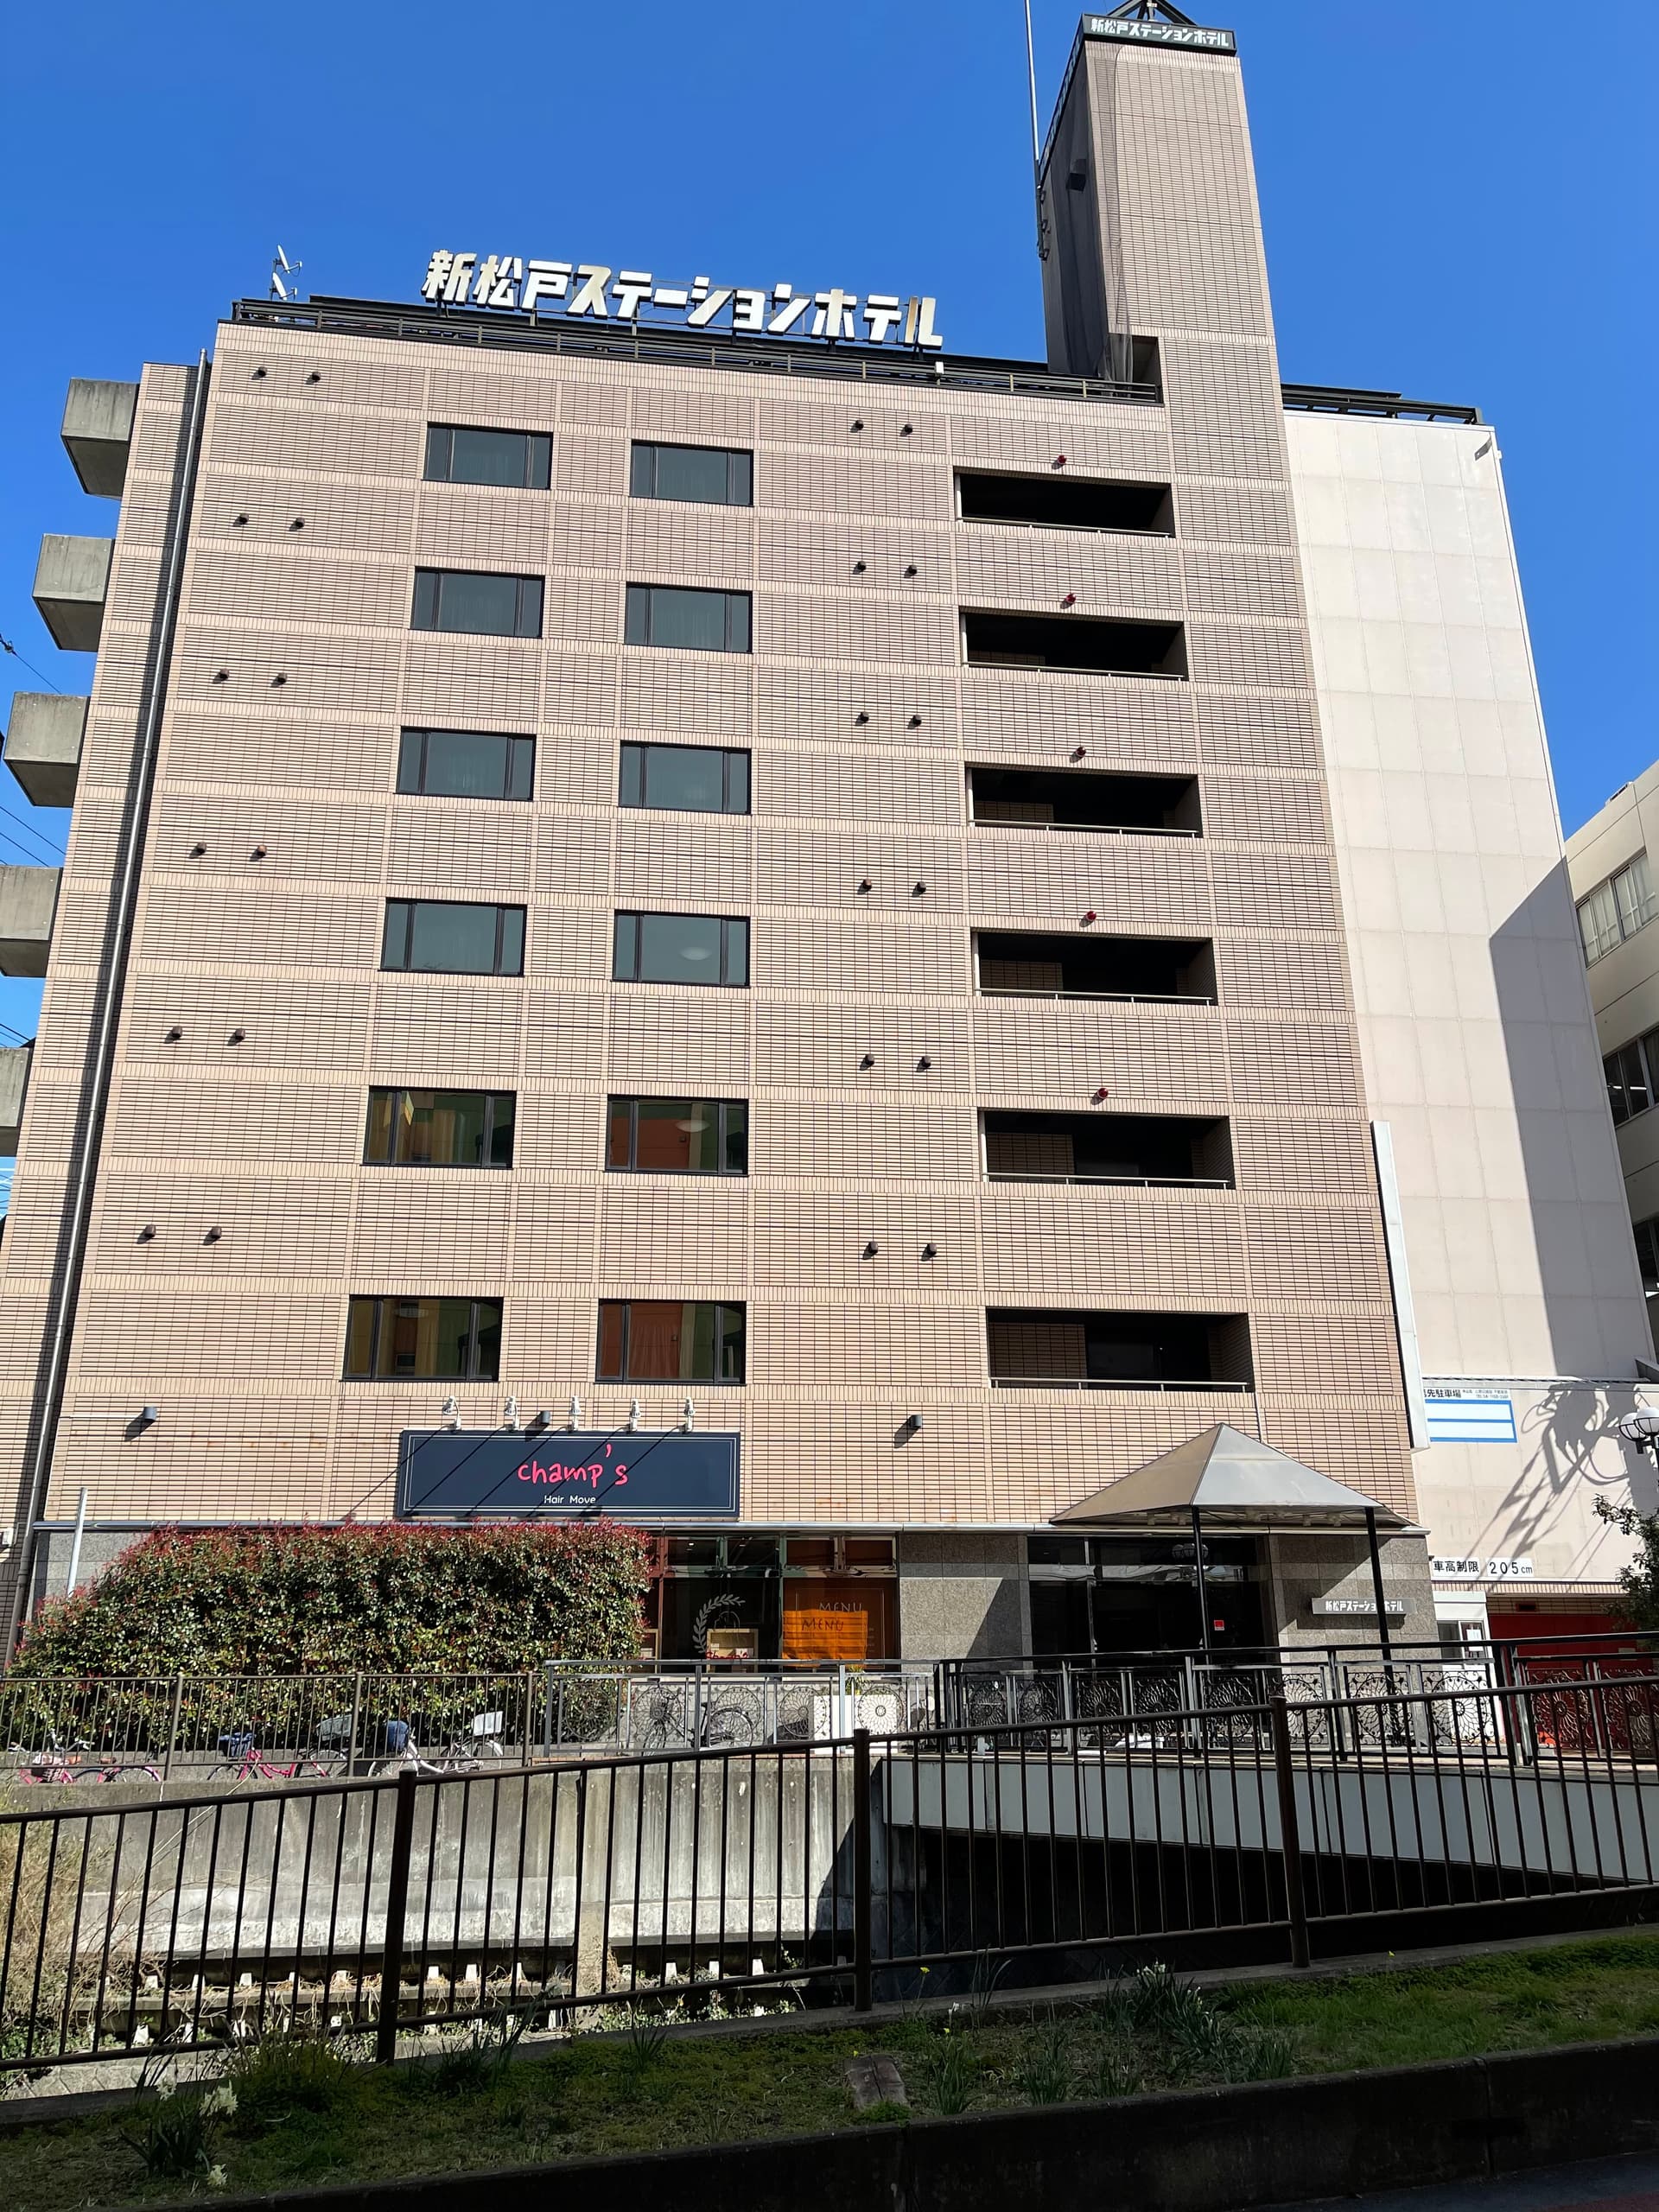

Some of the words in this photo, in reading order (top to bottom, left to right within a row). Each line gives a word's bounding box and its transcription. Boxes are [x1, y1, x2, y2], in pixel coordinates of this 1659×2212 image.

[1090, 18, 1229, 47] 新松戸ステーションホテル
[421, 249, 944, 349] 新松戸ステーションホテル
[544, 1495, 564, 1504] Hair
[569, 1495, 597, 1504] Move
[1433, 1560, 1479, 1573] 車高制限
[1325, 1600, 1404, 1611] 新松戸ステーショホテル
